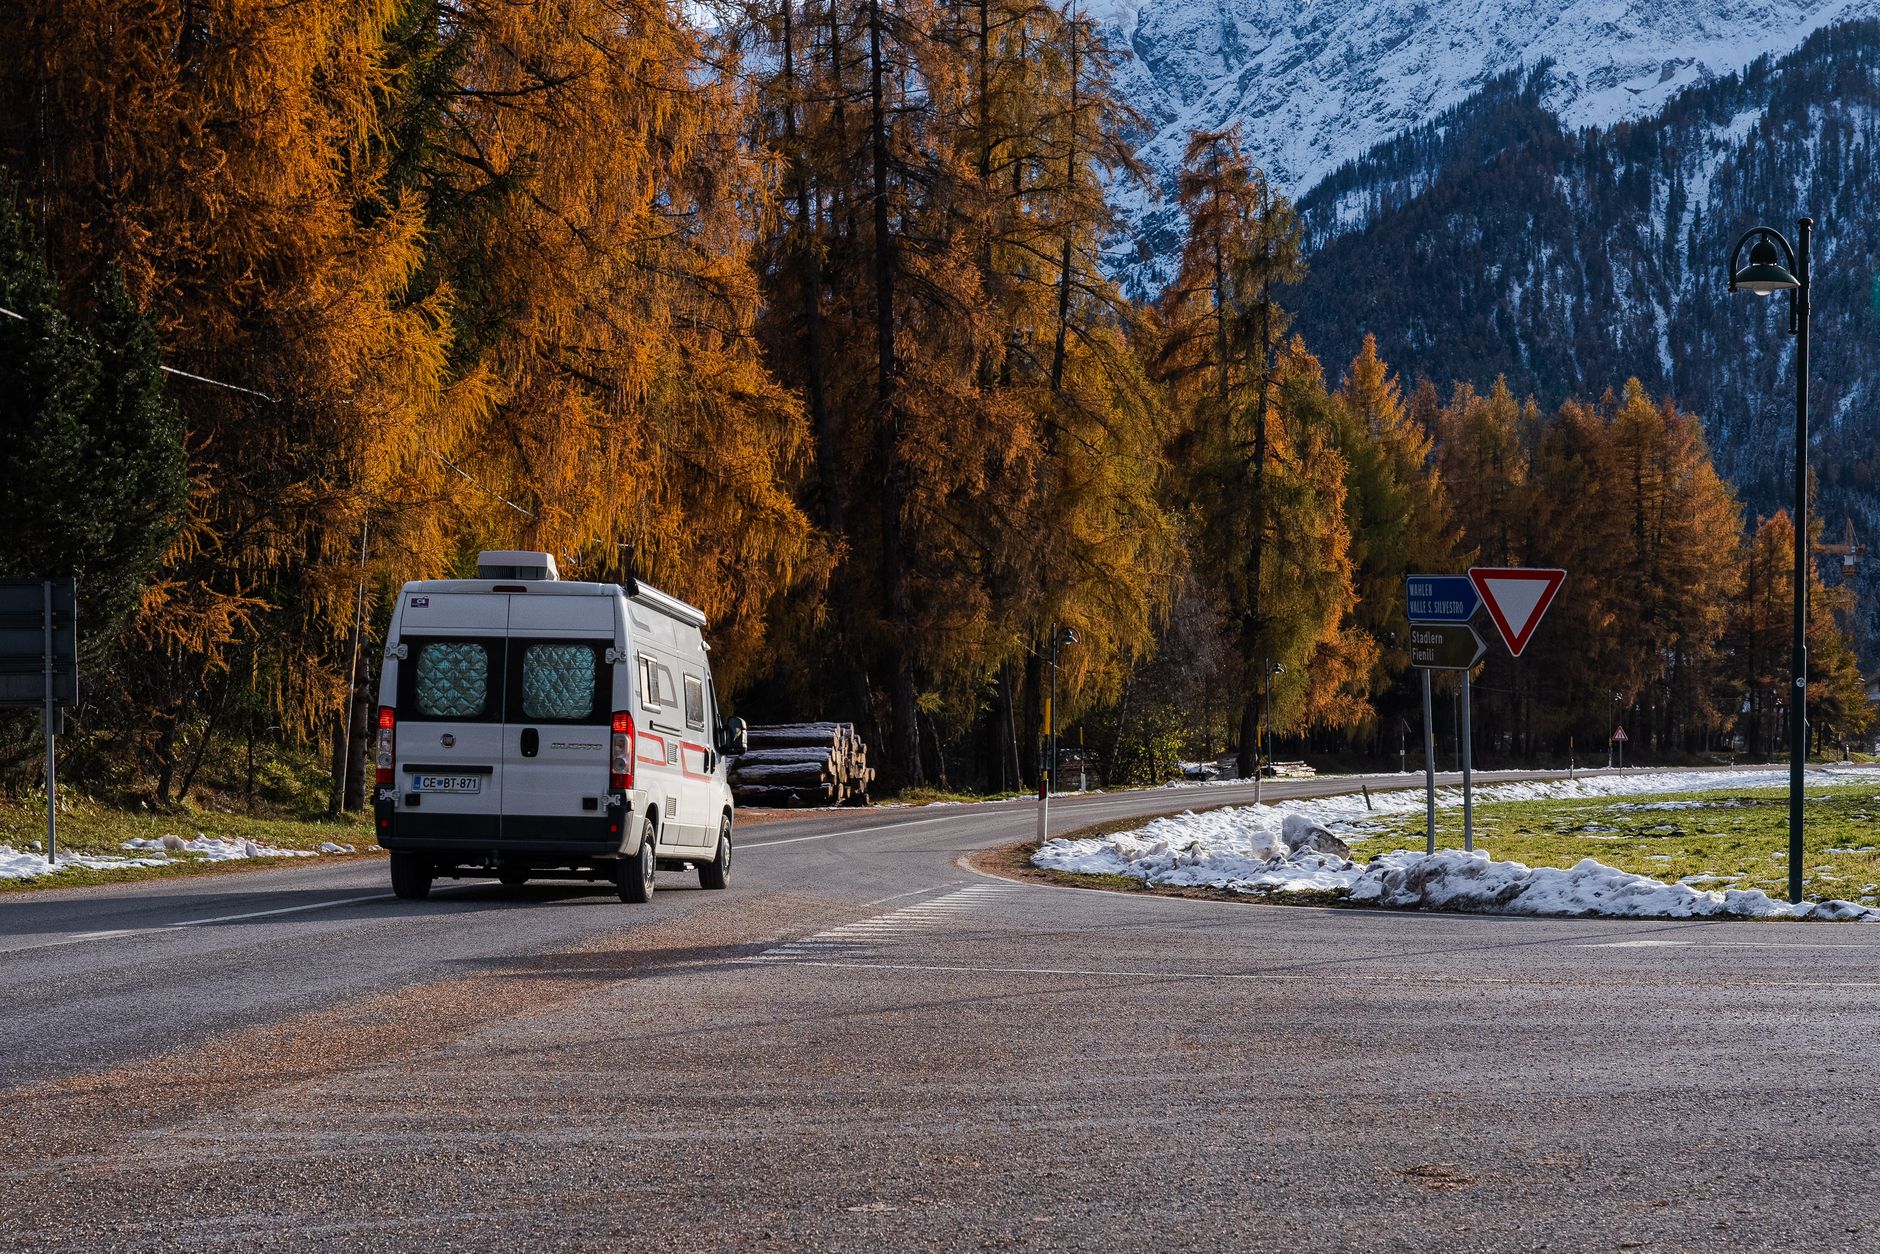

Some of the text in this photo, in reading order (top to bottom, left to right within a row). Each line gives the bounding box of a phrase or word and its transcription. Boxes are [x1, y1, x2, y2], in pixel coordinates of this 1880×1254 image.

[1409, 583, 1433, 597] WAHLEN
[1410, 600, 1426, 614] VALLE
[1434, 600, 1464, 615] SILVESTRO
[1411, 630, 1443, 645] Stadlern
[1412, 647, 1435, 661] Fienili
[423, 777, 477, 789] CE BT-871
